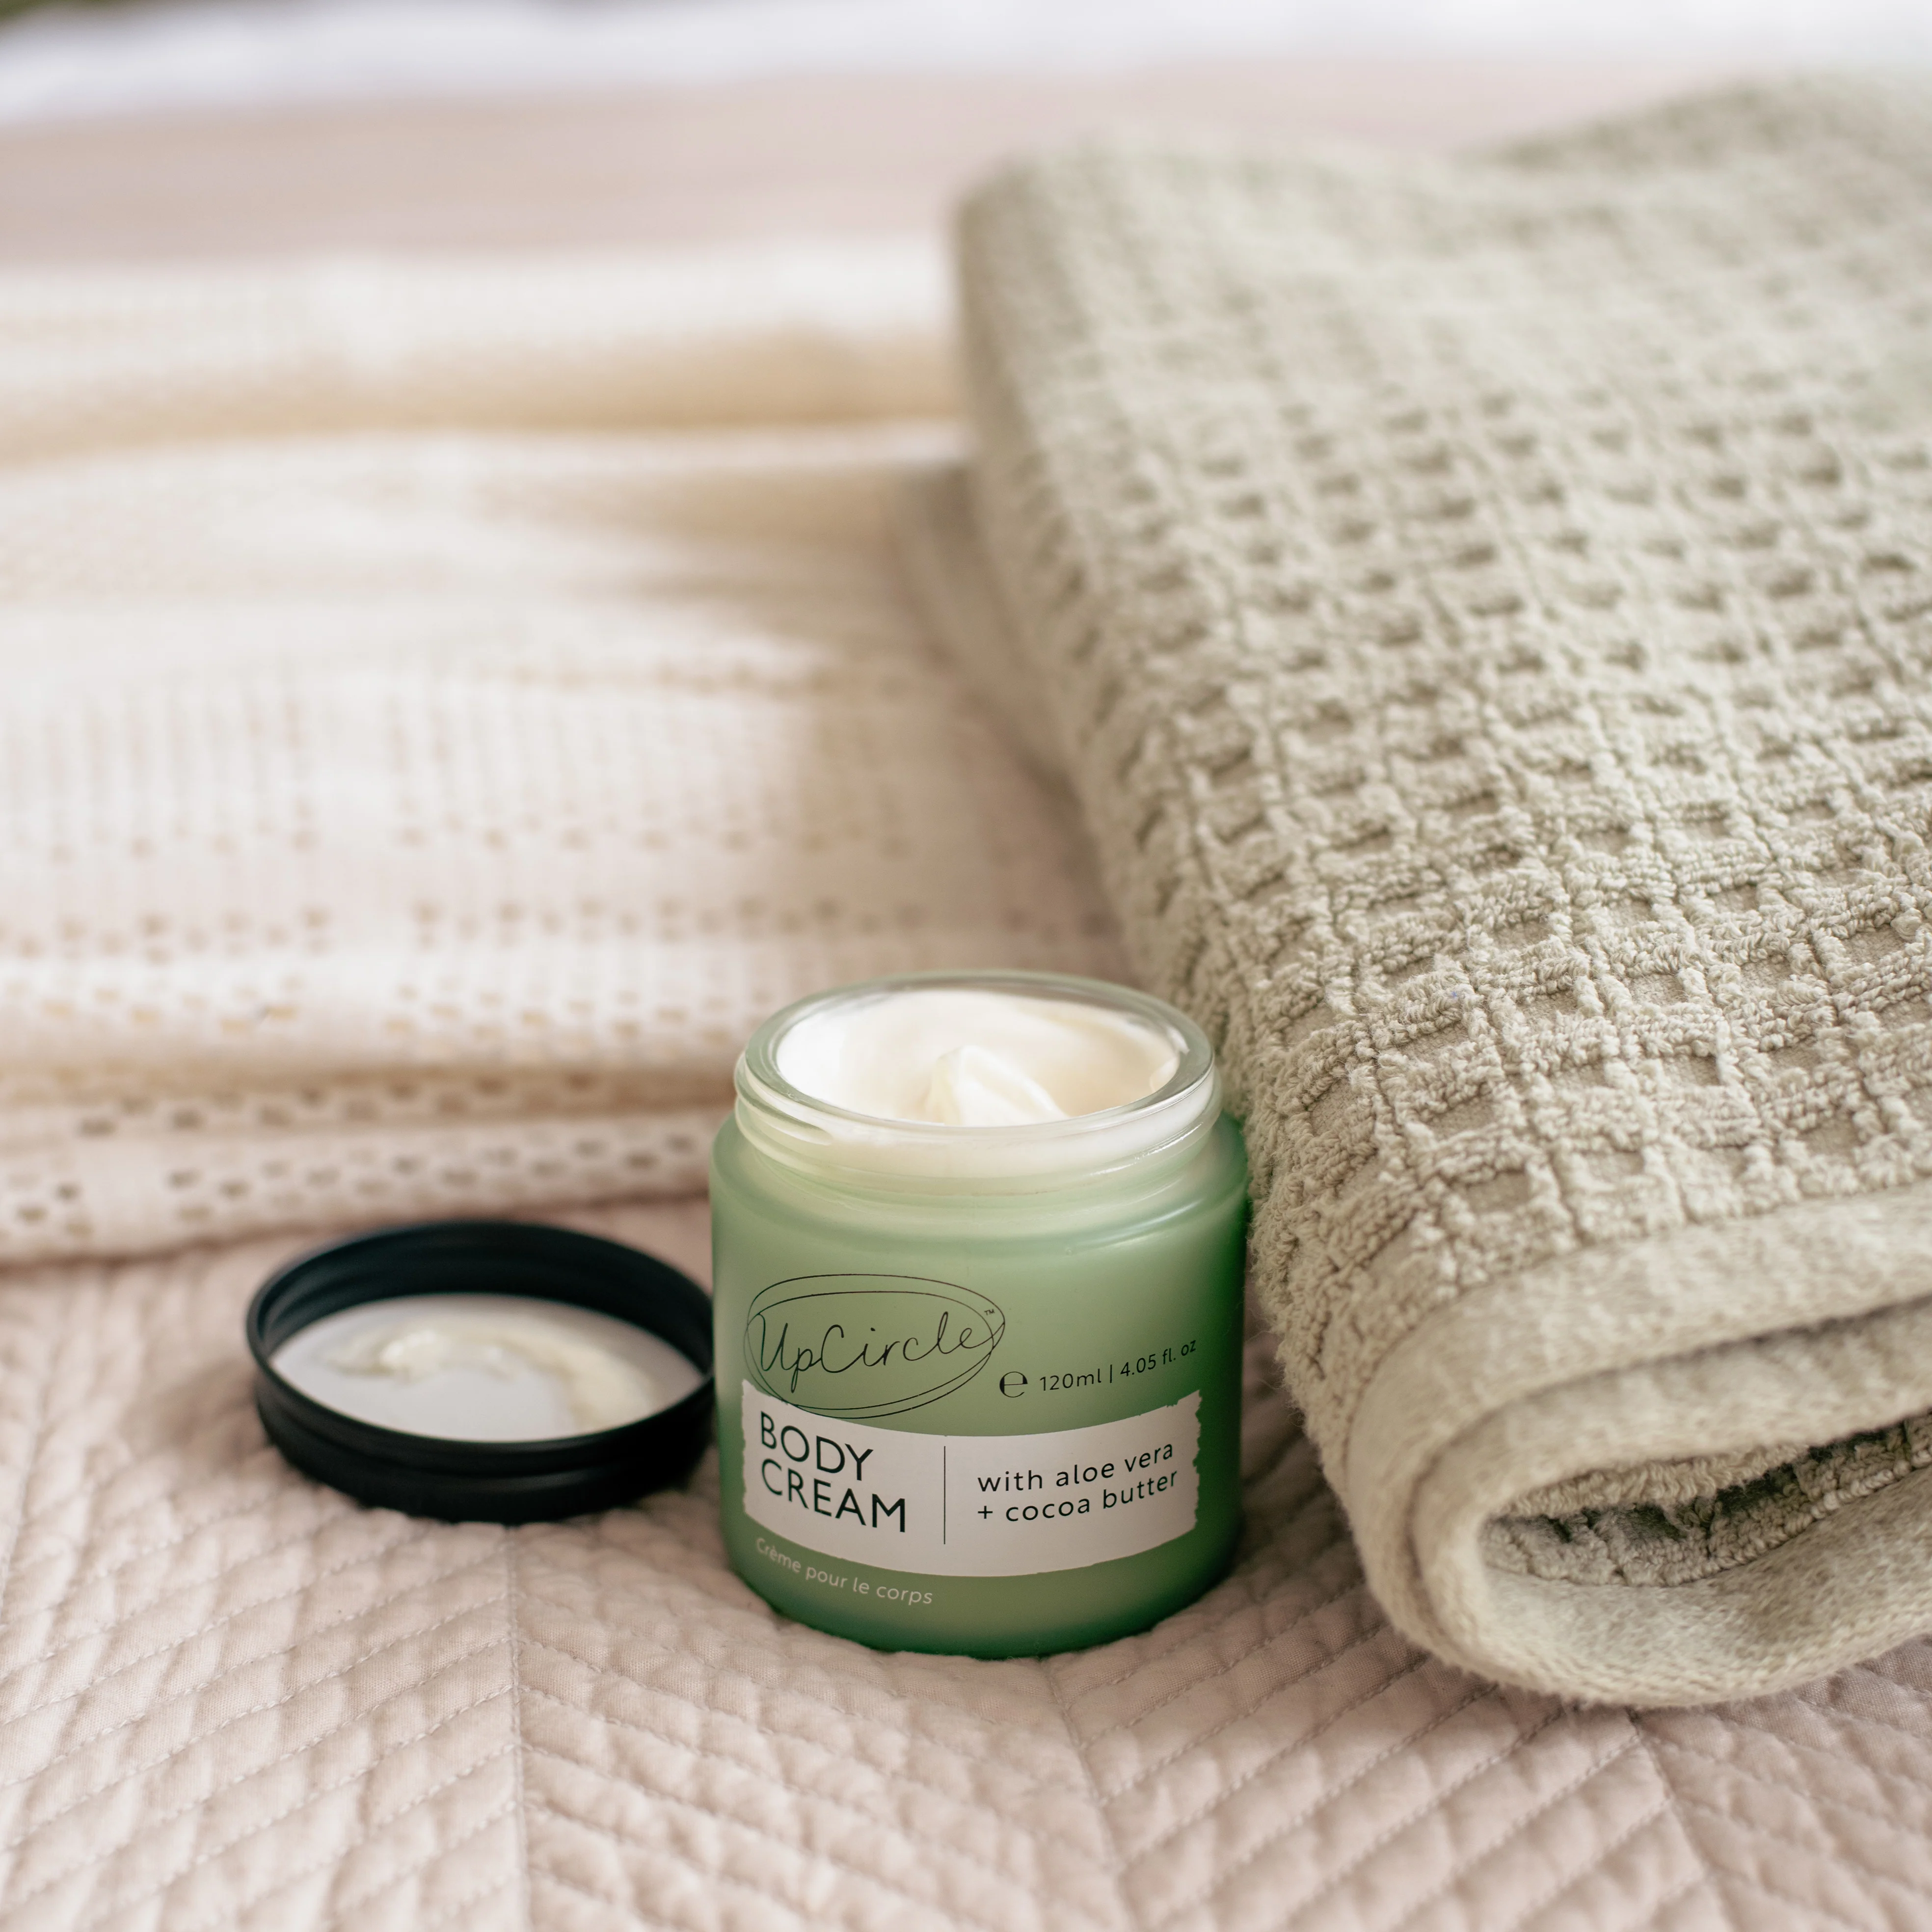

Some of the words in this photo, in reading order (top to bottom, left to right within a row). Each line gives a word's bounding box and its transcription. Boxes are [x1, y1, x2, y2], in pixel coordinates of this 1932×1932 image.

[757, 1311, 987, 1393] UpCircle
[1040, 1368, 1101, 1391] 120ml
[1120, 1354, 1156, 1376] 4.05
[1162, 1348, 1176, 1365] fl.
[1181, 1340, 1196, 1356] oz
[760, 1410, 874, 1481] BODY
[978, 1470, 1043, 1492] with
[1056, 1463, 1114, 1486] aloe
[1125, 1444, 1173, 1472] vera
[762, 1458, 905, 1532] CREAM
[1006, 1498, 1090, 1522] cocoa
[1103, 1471, 1177, 1509] butter
[756, 1537, 801, 1574] Crème
[805, 1566, 848, 1588] pour
[853, 1577, 870, 1594] le
[876, 1585, 933, 1606] corps
